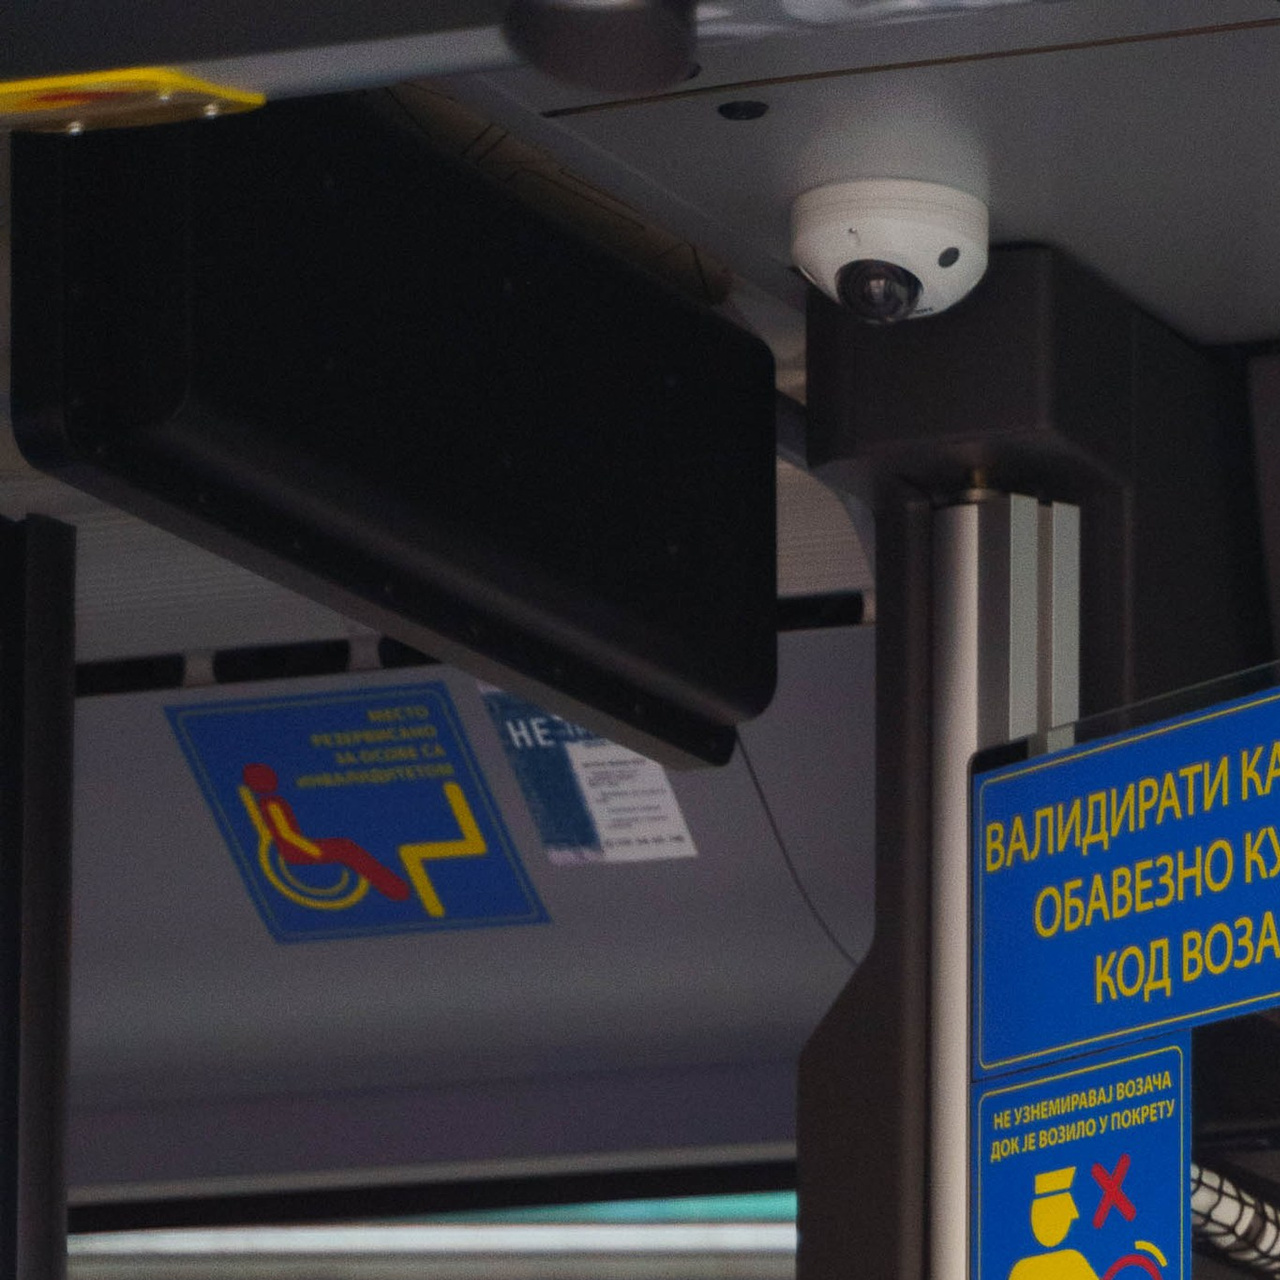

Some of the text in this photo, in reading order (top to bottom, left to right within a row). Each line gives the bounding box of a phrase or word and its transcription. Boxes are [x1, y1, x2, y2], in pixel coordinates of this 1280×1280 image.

[985, 756, 1230, 874] ВАЛИДИРАТИ
[1034, 839, 1234, 939] ОБАВЕЗНО
[1095, 938, 1172, 1003] КОД
[990, 1099, 1175, 1163] ДОК ЈЕ ВОЗИЛО У ПОКРЕТУ
[993, 1071, 1171, 1130] НЕ УЗНЕМИРАВАЈ ВОЗАЧА
